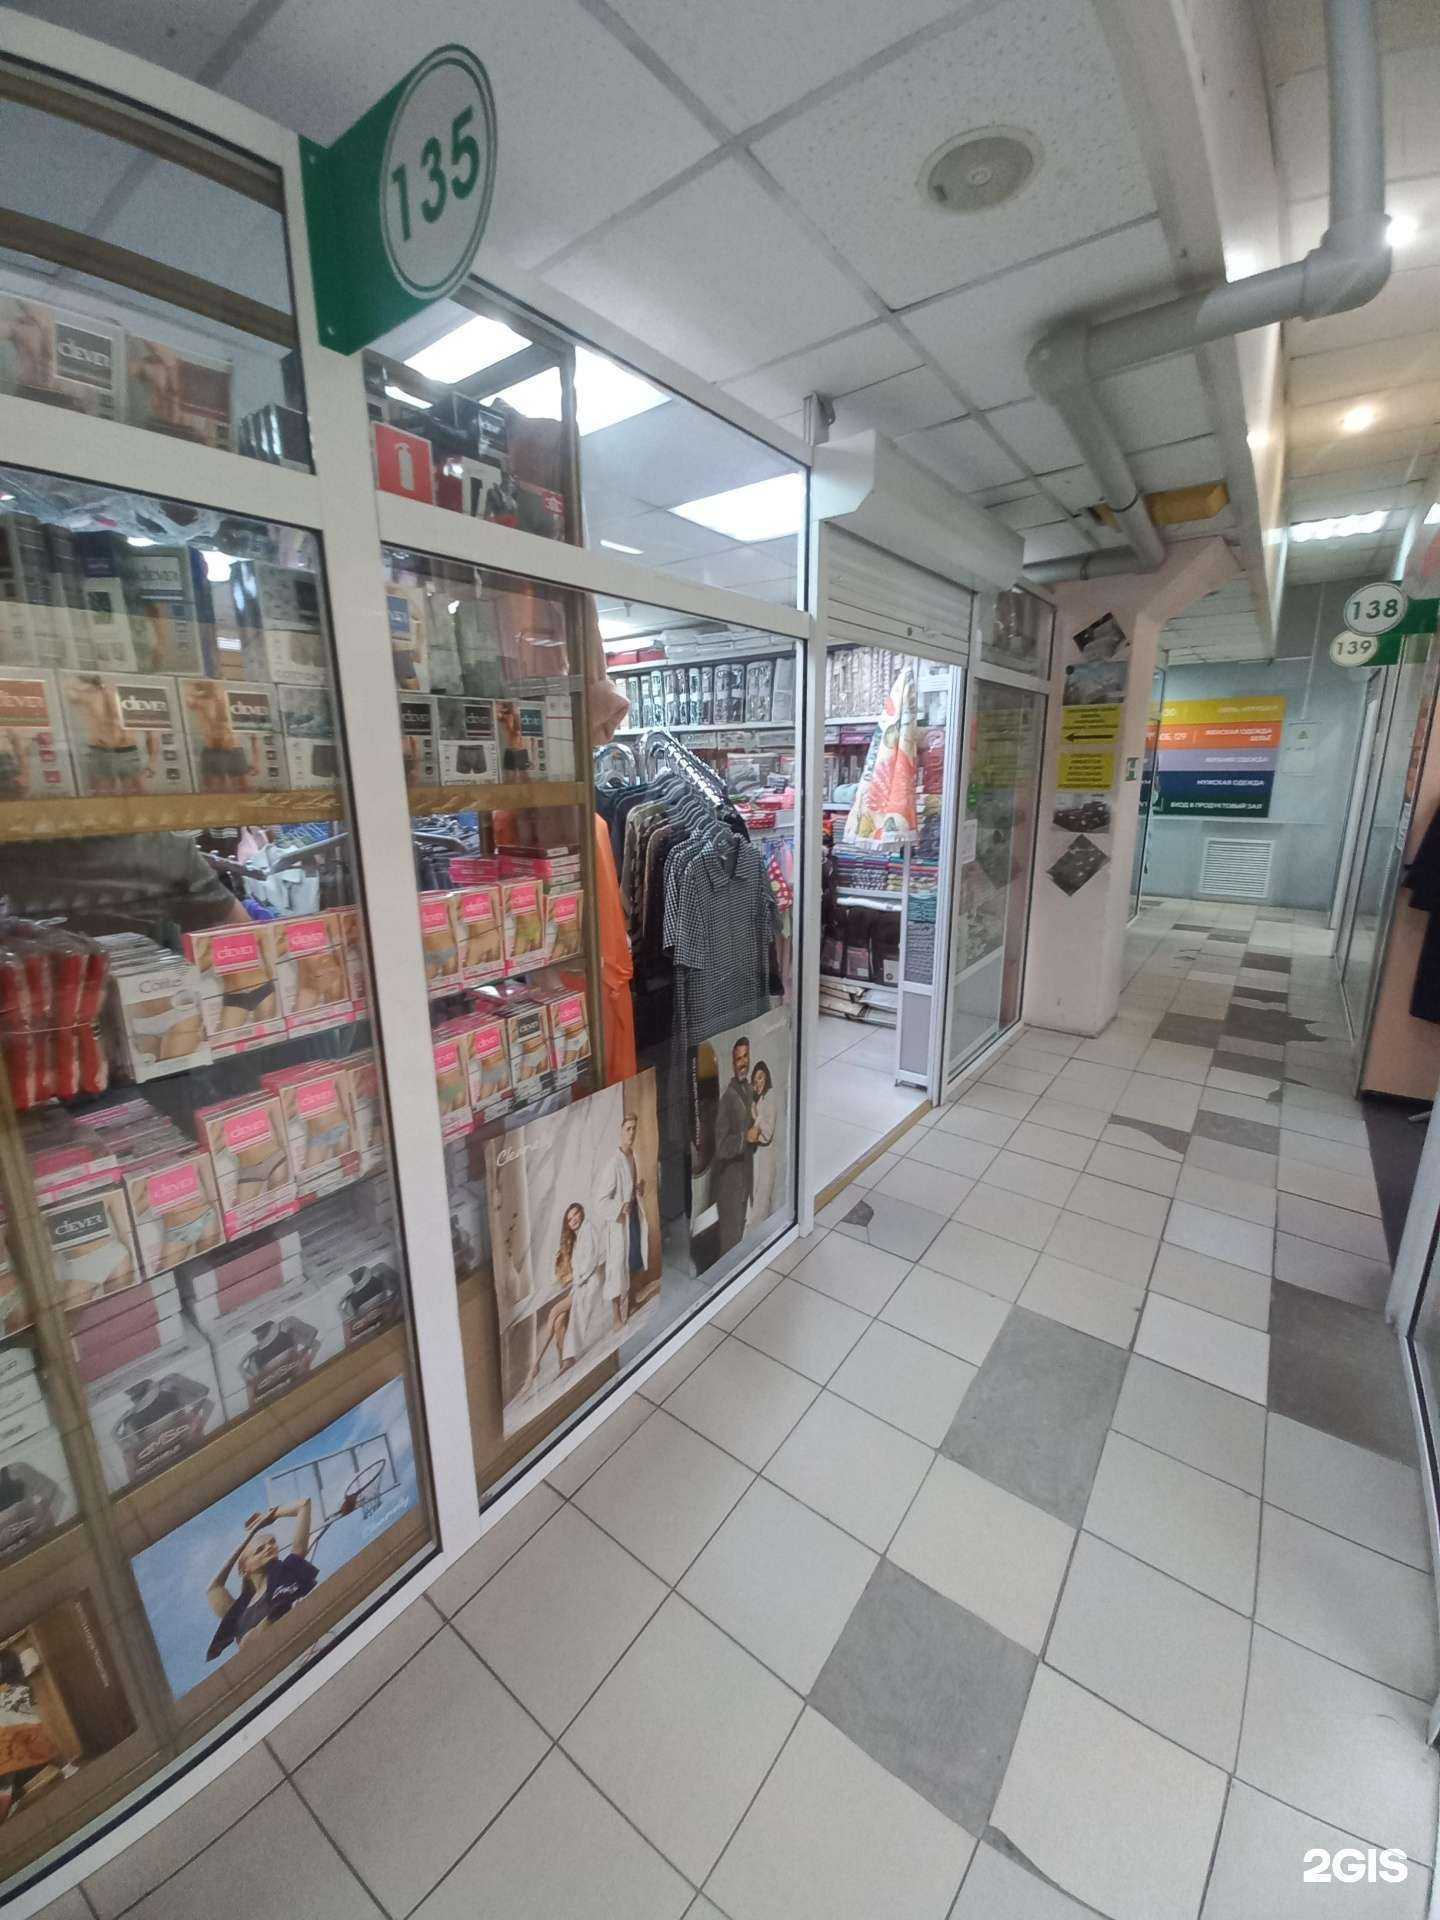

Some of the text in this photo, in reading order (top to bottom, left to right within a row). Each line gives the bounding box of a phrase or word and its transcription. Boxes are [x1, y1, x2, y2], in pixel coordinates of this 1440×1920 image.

[390, 105, 480, 242] 135
[1352, 598, 1399, 620] 138
[1336, 640, 1372, 656] 139
